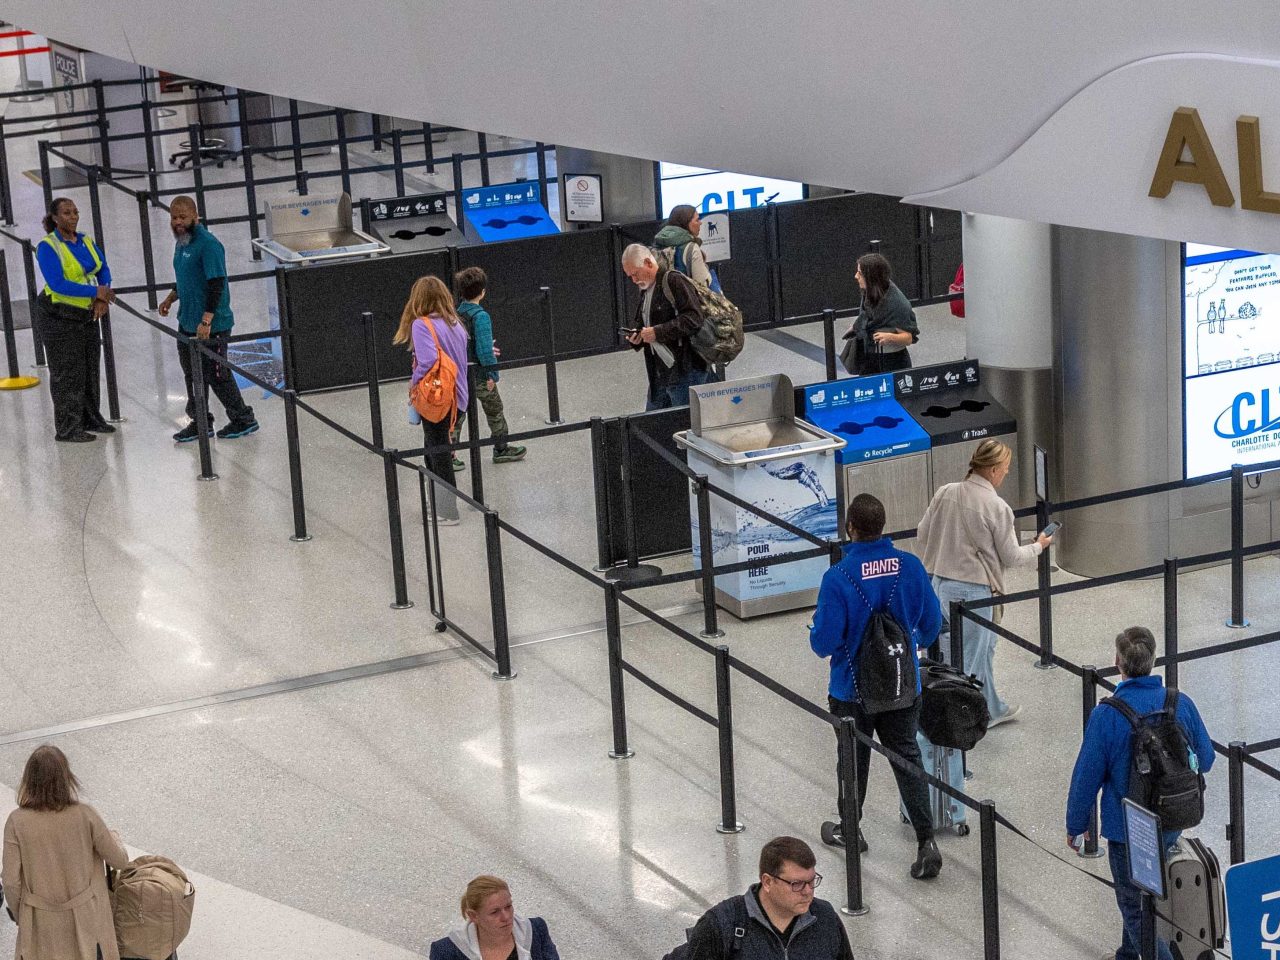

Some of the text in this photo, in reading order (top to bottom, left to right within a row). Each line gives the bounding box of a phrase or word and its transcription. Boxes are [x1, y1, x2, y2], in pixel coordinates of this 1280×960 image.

[56, 55, 76, 75] POLICE
[716, 385, 756, 396] BEVERAGES
[971, 427, 988, 437] Trash
[1231, 433, 1269, 448] CHARLOTTE
[871, 447, 893, 457] Recycle
[1237, 442, 1276, 454] INTERNATIONAL
[747, 544, 769, 556] POUR
[748, 566, 768, 578] HERE
[861, 557, 899, 576] GIANTS
